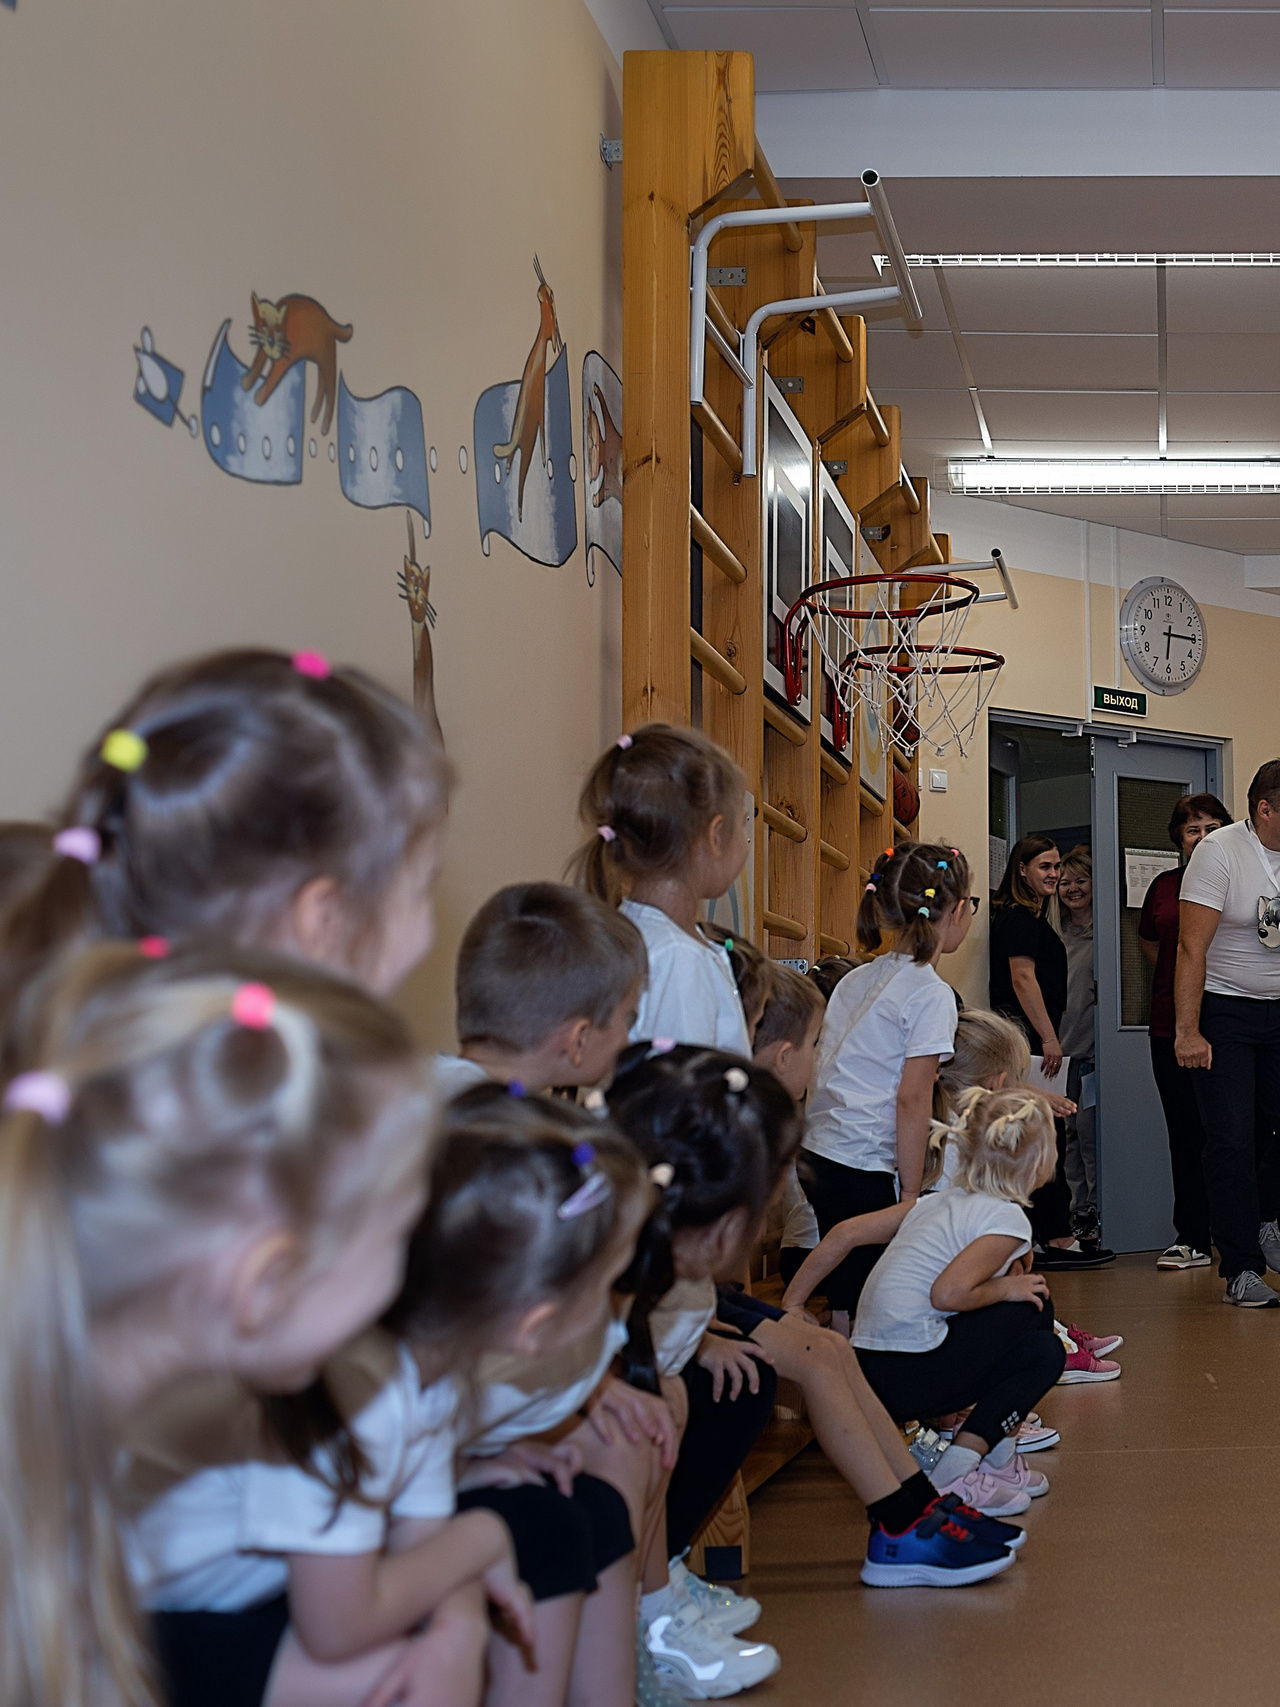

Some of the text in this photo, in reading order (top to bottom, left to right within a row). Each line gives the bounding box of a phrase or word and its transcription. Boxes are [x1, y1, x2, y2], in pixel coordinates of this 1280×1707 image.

[1152, 597, 1160, 609] 11
[1164, 595, 1172, 607] 12
[1143, 609, 1153, 620] 10
[1186, 616, 1193, 627] 2
[1140, 625, 1146, 636] 9
[1191, 633, 1197, 644] 3
[1144, 641, 1150, 652] 8
[1187, 649, 1193, 659] 4
[1152, 656, 1159, 667] 7
[1179, 661, 1186, 672] 5
[1165, 663, 1172, 674] 6
[1103, 693, 1138, 711] ВЫХОД
